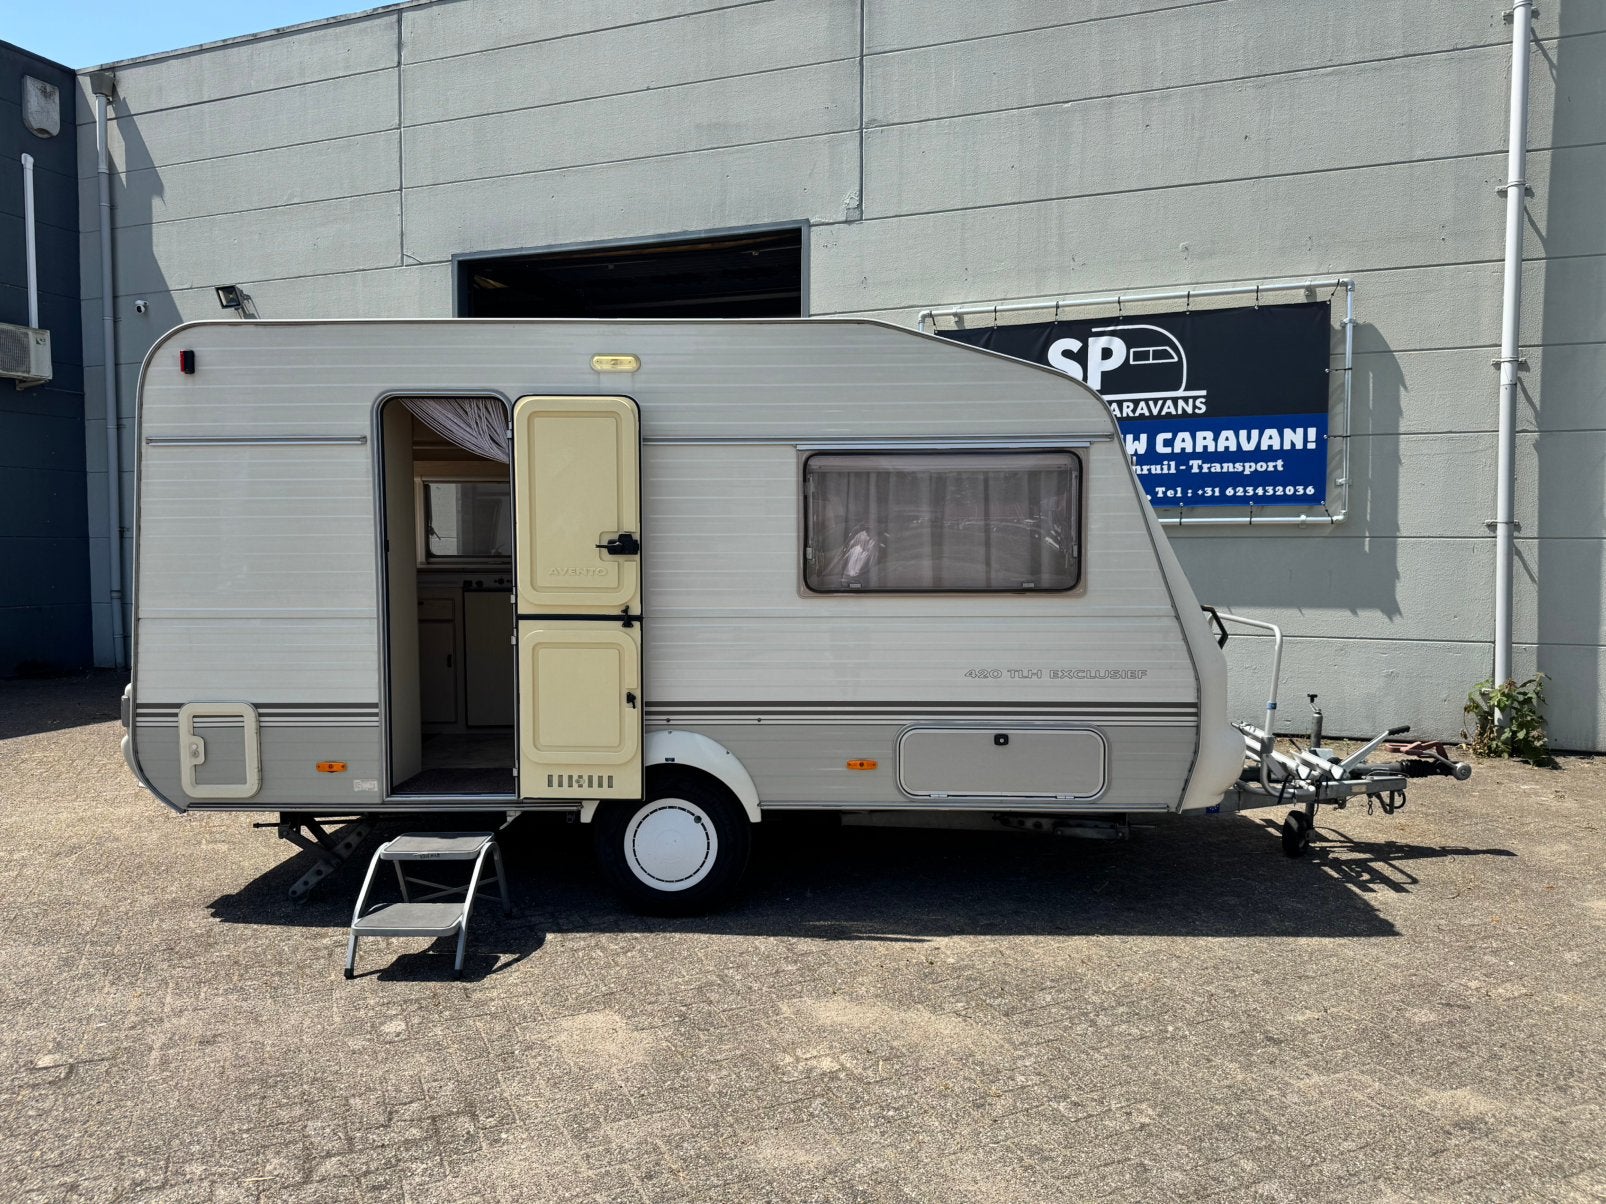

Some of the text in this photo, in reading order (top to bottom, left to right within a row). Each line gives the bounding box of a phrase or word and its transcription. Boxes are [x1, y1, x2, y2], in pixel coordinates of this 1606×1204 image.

[1047, 336, 1127, 390] SP
[1110, 398, 1207, 417] ARAVANS
[1125, 427, 1317, 455] W CARAVAN!
[1189, 459, 1284, 475] Transport
[1197, 487, 1220, 497] +31
[1225, 485, 1315, 497] 623432036
[548, 567, 608, 577] AVENTO
[964, 669, 1148, 679] 420 TLH EXCLUSIEF
